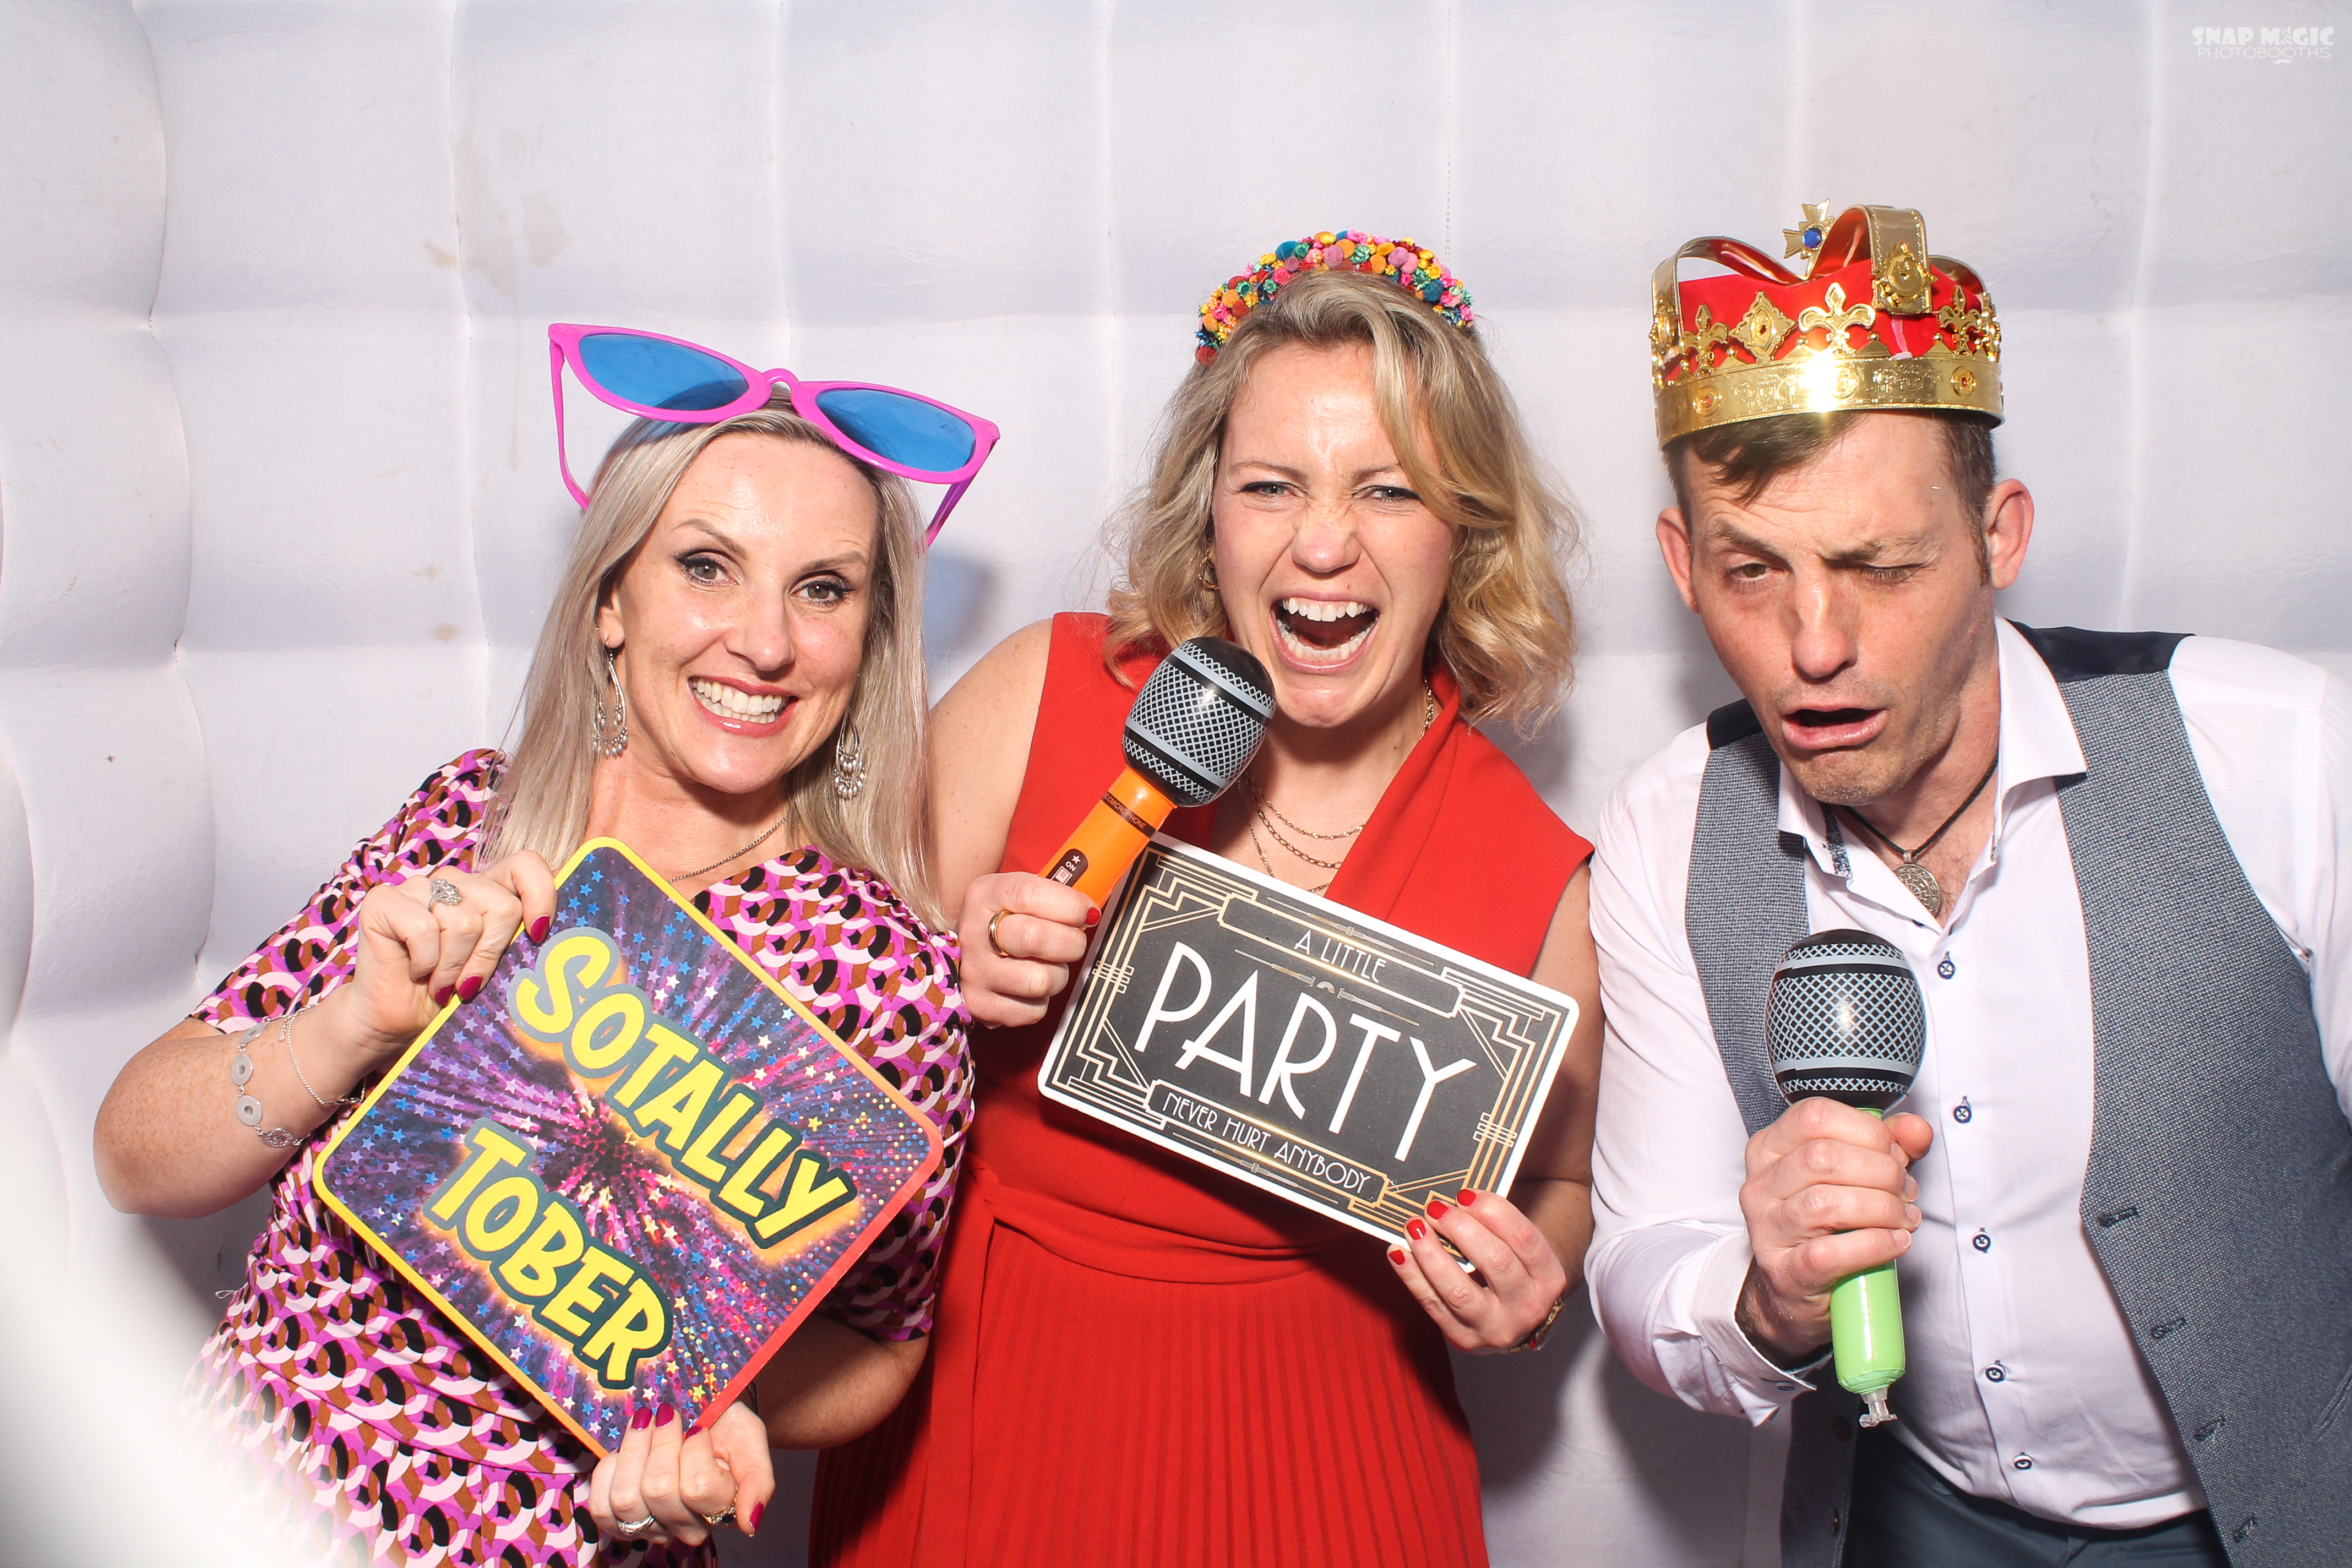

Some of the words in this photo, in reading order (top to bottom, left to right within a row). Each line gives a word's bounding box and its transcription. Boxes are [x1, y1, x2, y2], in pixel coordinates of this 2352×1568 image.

[1065, 861, 1077, 872] ON
[1293, 929, 1311, 955] A
[1320, 938, 1387, 983] LITTLE
[512, 932, 853, 1244] SOTALLY
[1134, 941, 1478, 1163] PARTY
[1162, 1092, 1218, 1131] NEVER
[1222, 1117, 1271, 1152] HURT
[1273, 1141, 1371, 1194] ANYBODY
[427, 1123, 669, 1386] TOBER
